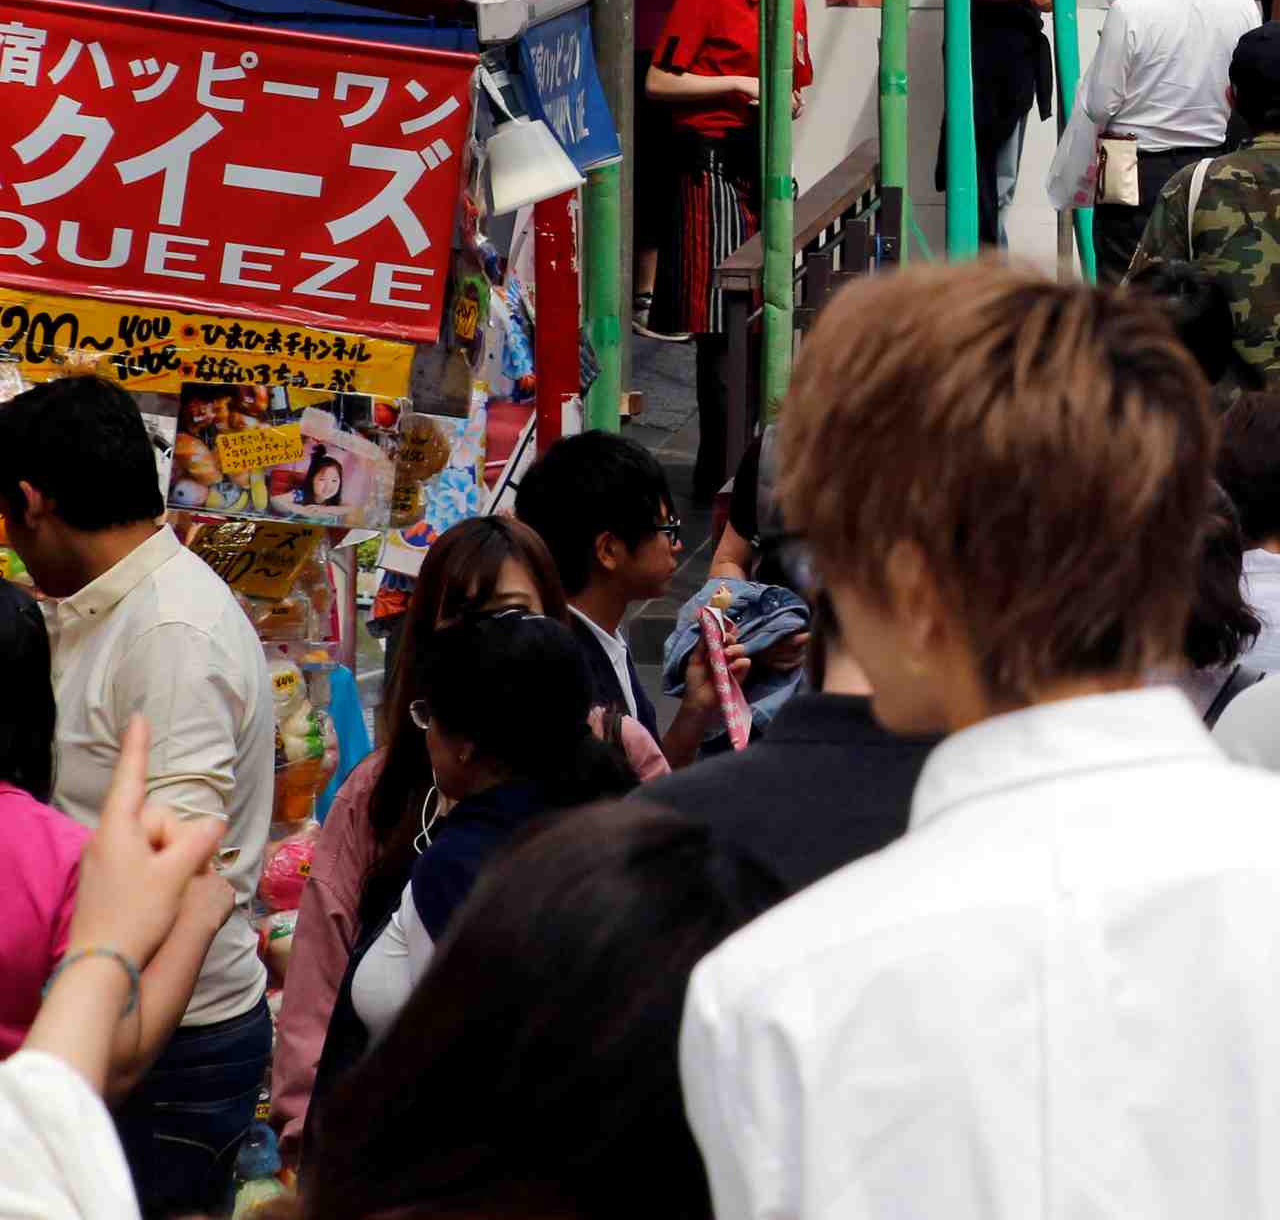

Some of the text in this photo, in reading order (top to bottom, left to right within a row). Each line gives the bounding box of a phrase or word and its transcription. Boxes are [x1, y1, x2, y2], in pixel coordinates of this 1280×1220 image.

[11, 92, 454, 258] クイーズ
[200, 322, 373, 363] ひまひまチャンネル
